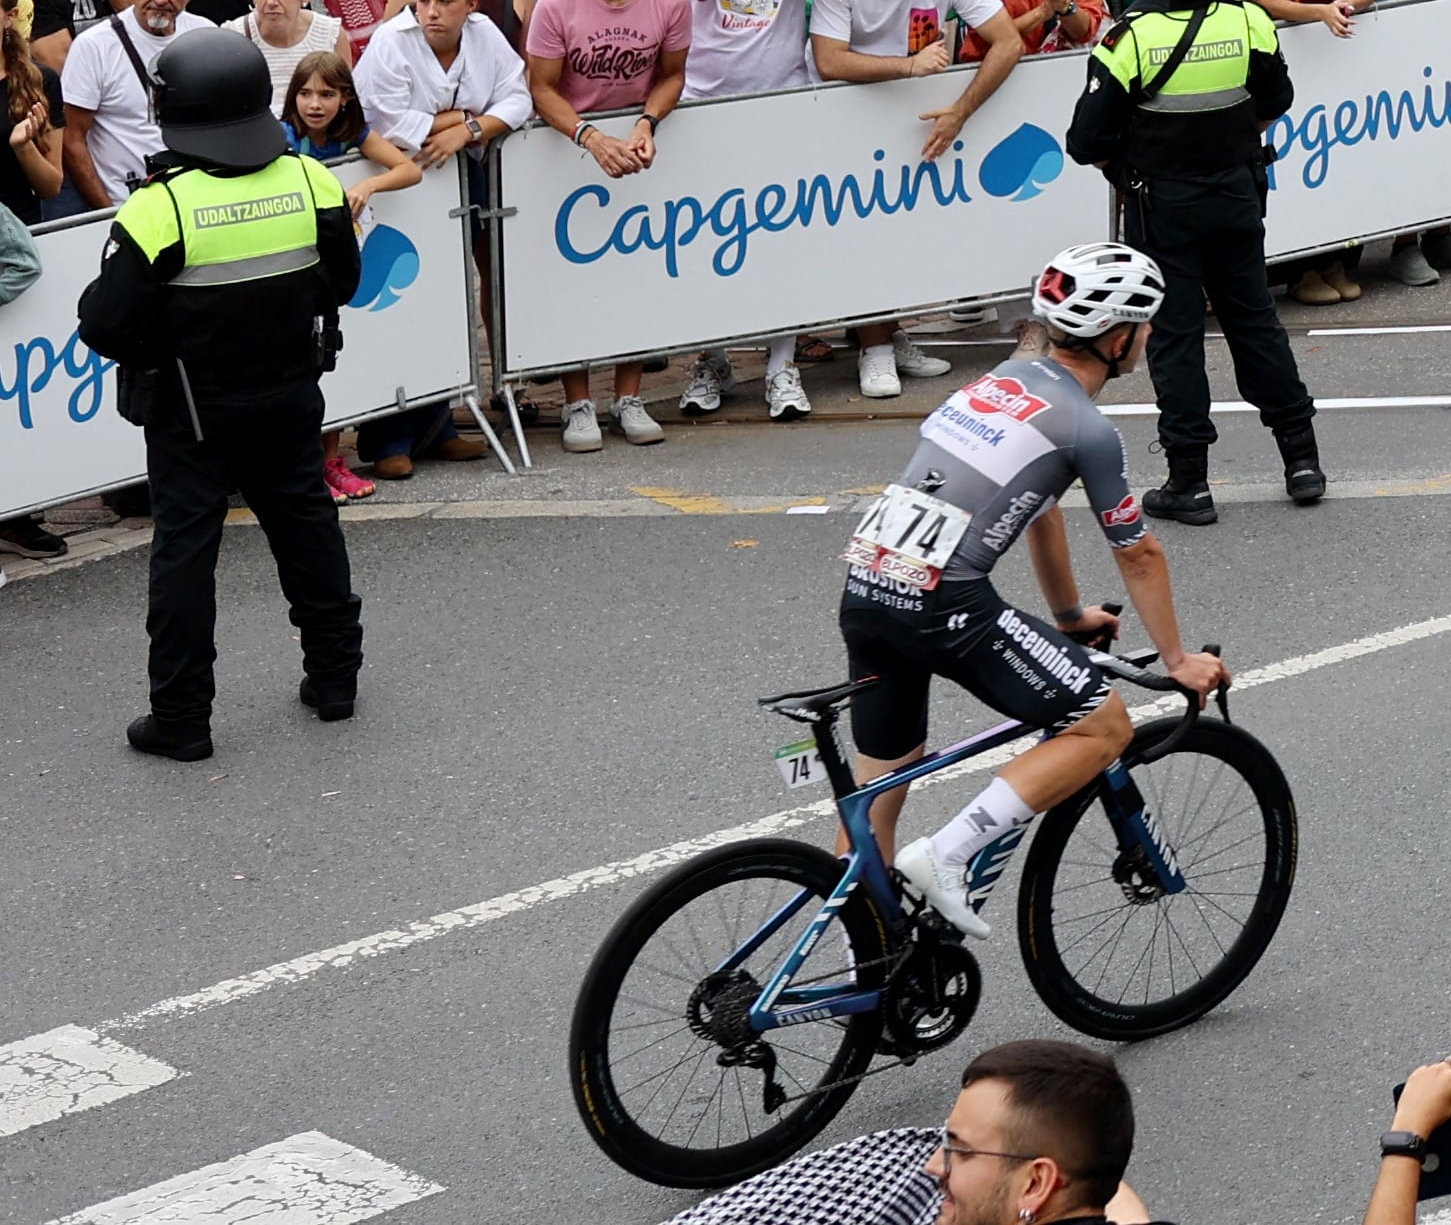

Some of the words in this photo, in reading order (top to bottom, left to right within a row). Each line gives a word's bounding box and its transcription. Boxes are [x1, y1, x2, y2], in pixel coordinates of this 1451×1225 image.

[587, 27, 649, 44] ALAGNAK
[721, 14, 771, 33] Vintage
[1151, 41, 1241, 65] UDTZAINGOA
[196, 195, 302, 227] UDALTZAINGOA
[555, 142, 972, 278] Capgemini
[971, 377, 1032, 415] Alpecin
[935, 401, 1007, 447] eceuninck
[894, 502, 949, 559] 74
[981, 490, 1042, 553] Alpecin
[847, 578, 869, 598] SUN
[871, 590, 924, 612] SYSTEMS
[996, 608, 1092, 695] deceuninck
[1001, 647, 1048, 692] WINDOWS
[788, 757, 812, 785] 74
